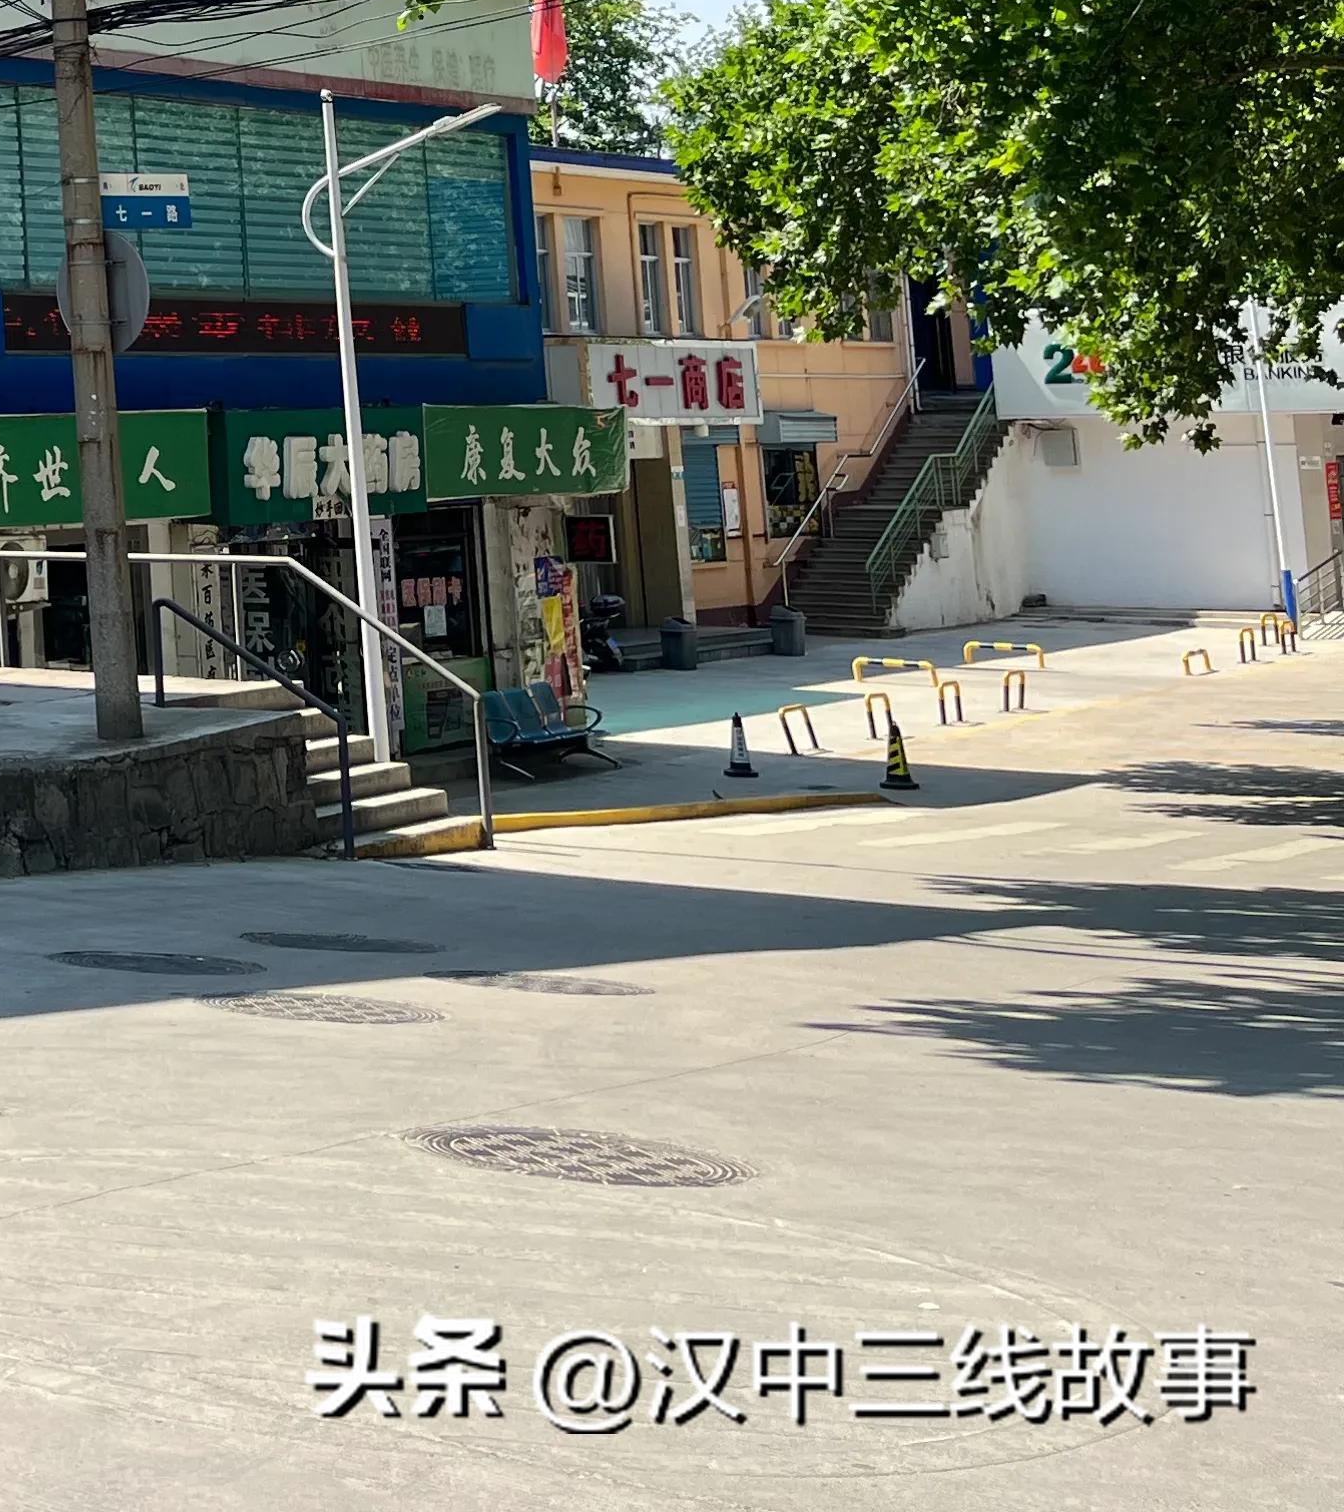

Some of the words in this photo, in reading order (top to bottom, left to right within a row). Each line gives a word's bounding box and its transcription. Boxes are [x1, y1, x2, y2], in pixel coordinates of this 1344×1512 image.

[115, 204, 179, 223] 七一路
[607, 354, 745, 411] 七一商店
[460, 424, 597, 486] 康复大众
